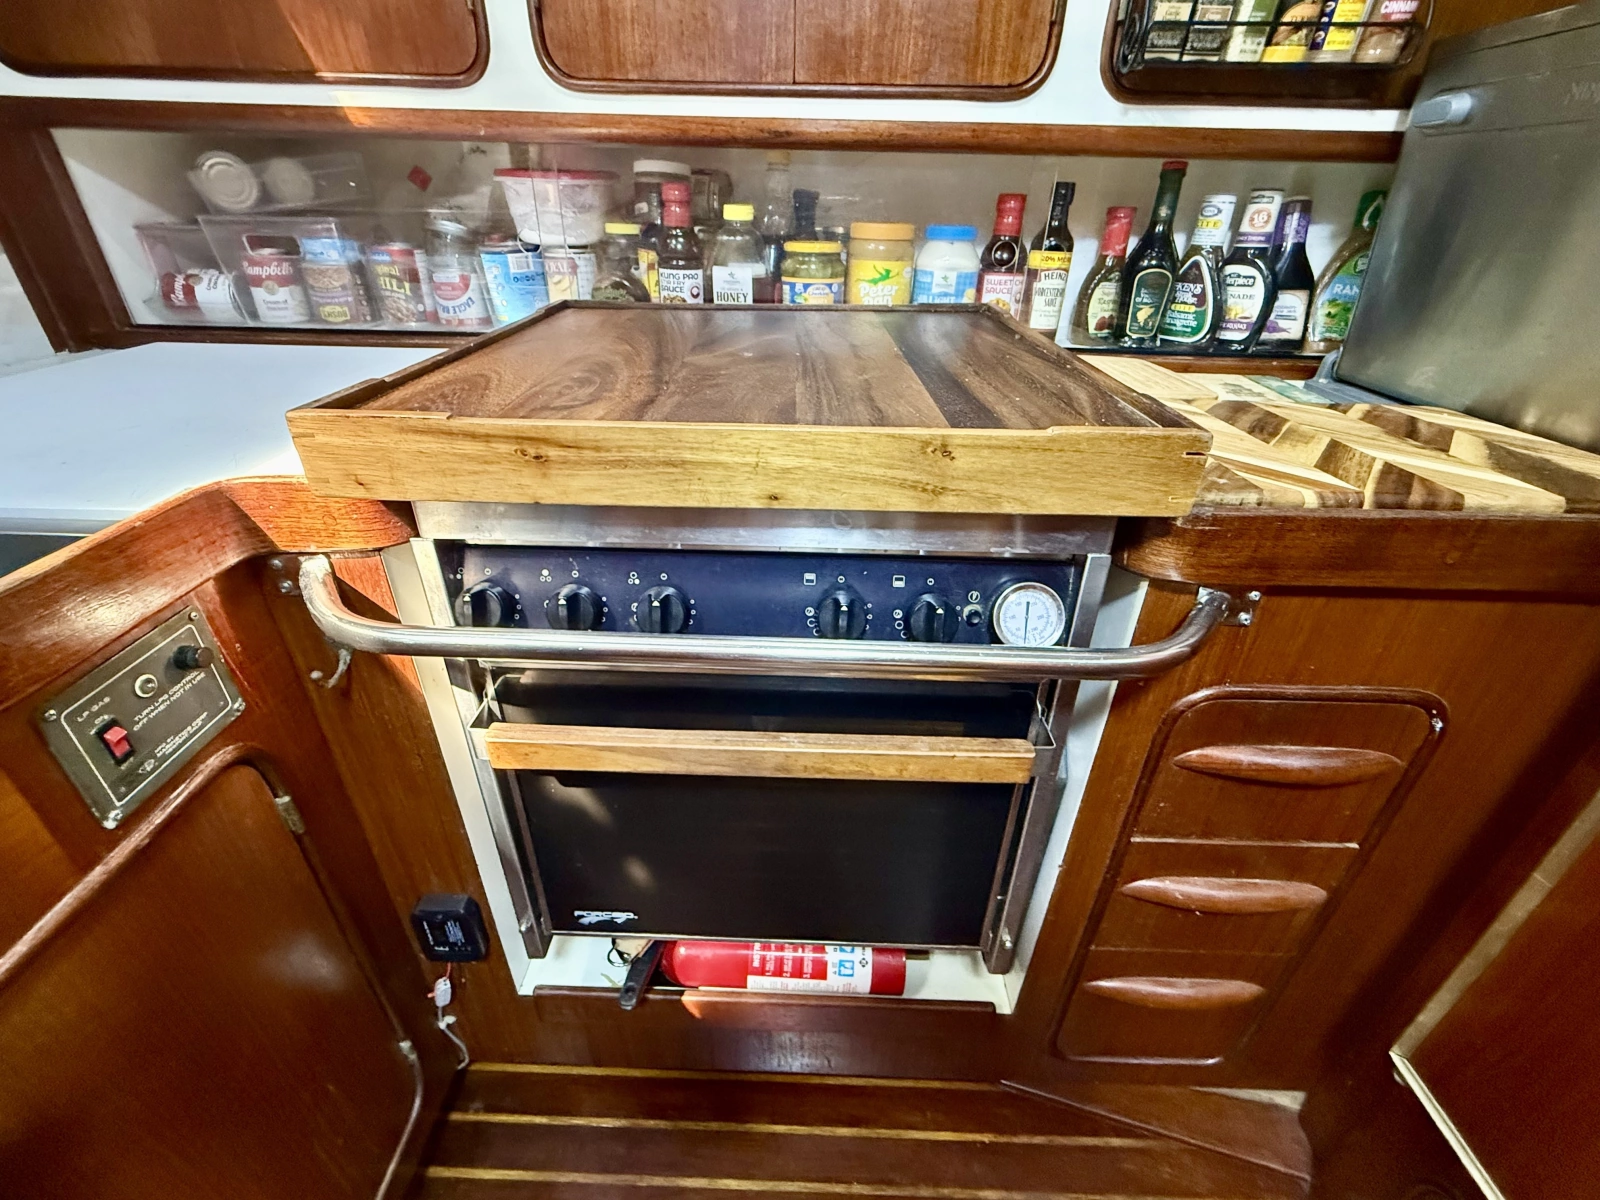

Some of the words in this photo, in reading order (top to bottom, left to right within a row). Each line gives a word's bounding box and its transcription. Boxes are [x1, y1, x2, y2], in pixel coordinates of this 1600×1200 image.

[716, 291, 749, 304] HONEY
[858, 283, 899, 299] Peter
[133, 704, 155, 722] TURN
[168, 671, 200, 695] CONTROL
[148, 700, 171, 718] WHEN
[169, 688, 185, 703] NOT
